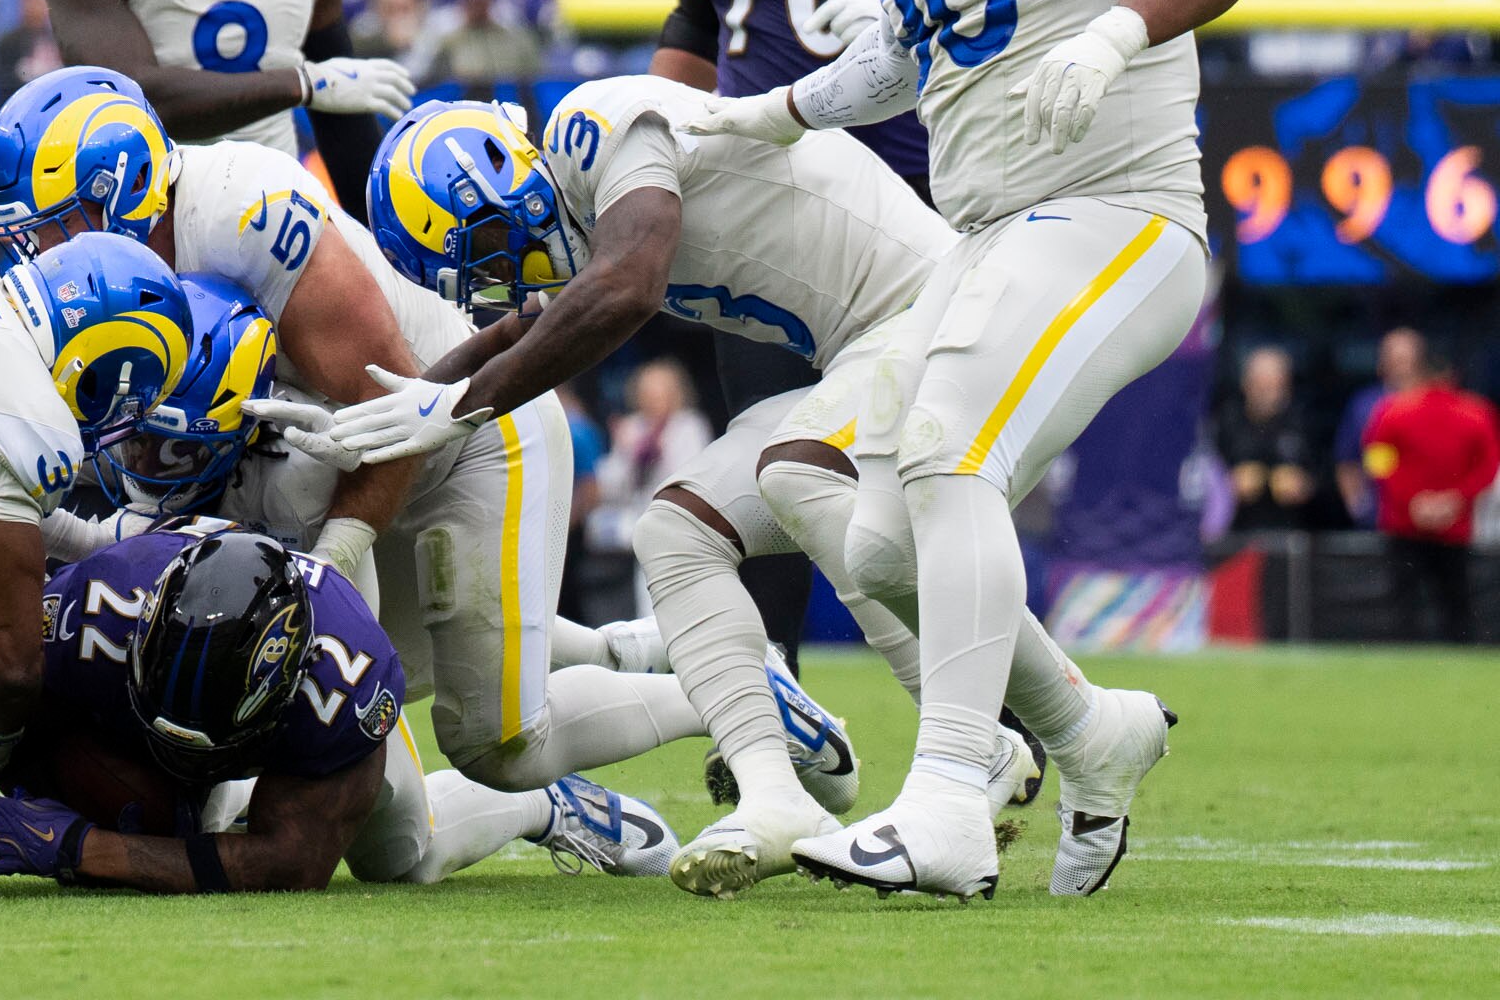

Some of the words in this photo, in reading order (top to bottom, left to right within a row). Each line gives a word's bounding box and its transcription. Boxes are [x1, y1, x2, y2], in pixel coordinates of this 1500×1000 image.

[565, 111, 600, 171] 3
[269, 189, 319, 271] 51
[37, 450, 74, 495] 3
[79, 579, 148, 664] 22
[299, 633, 375, 727] 22
